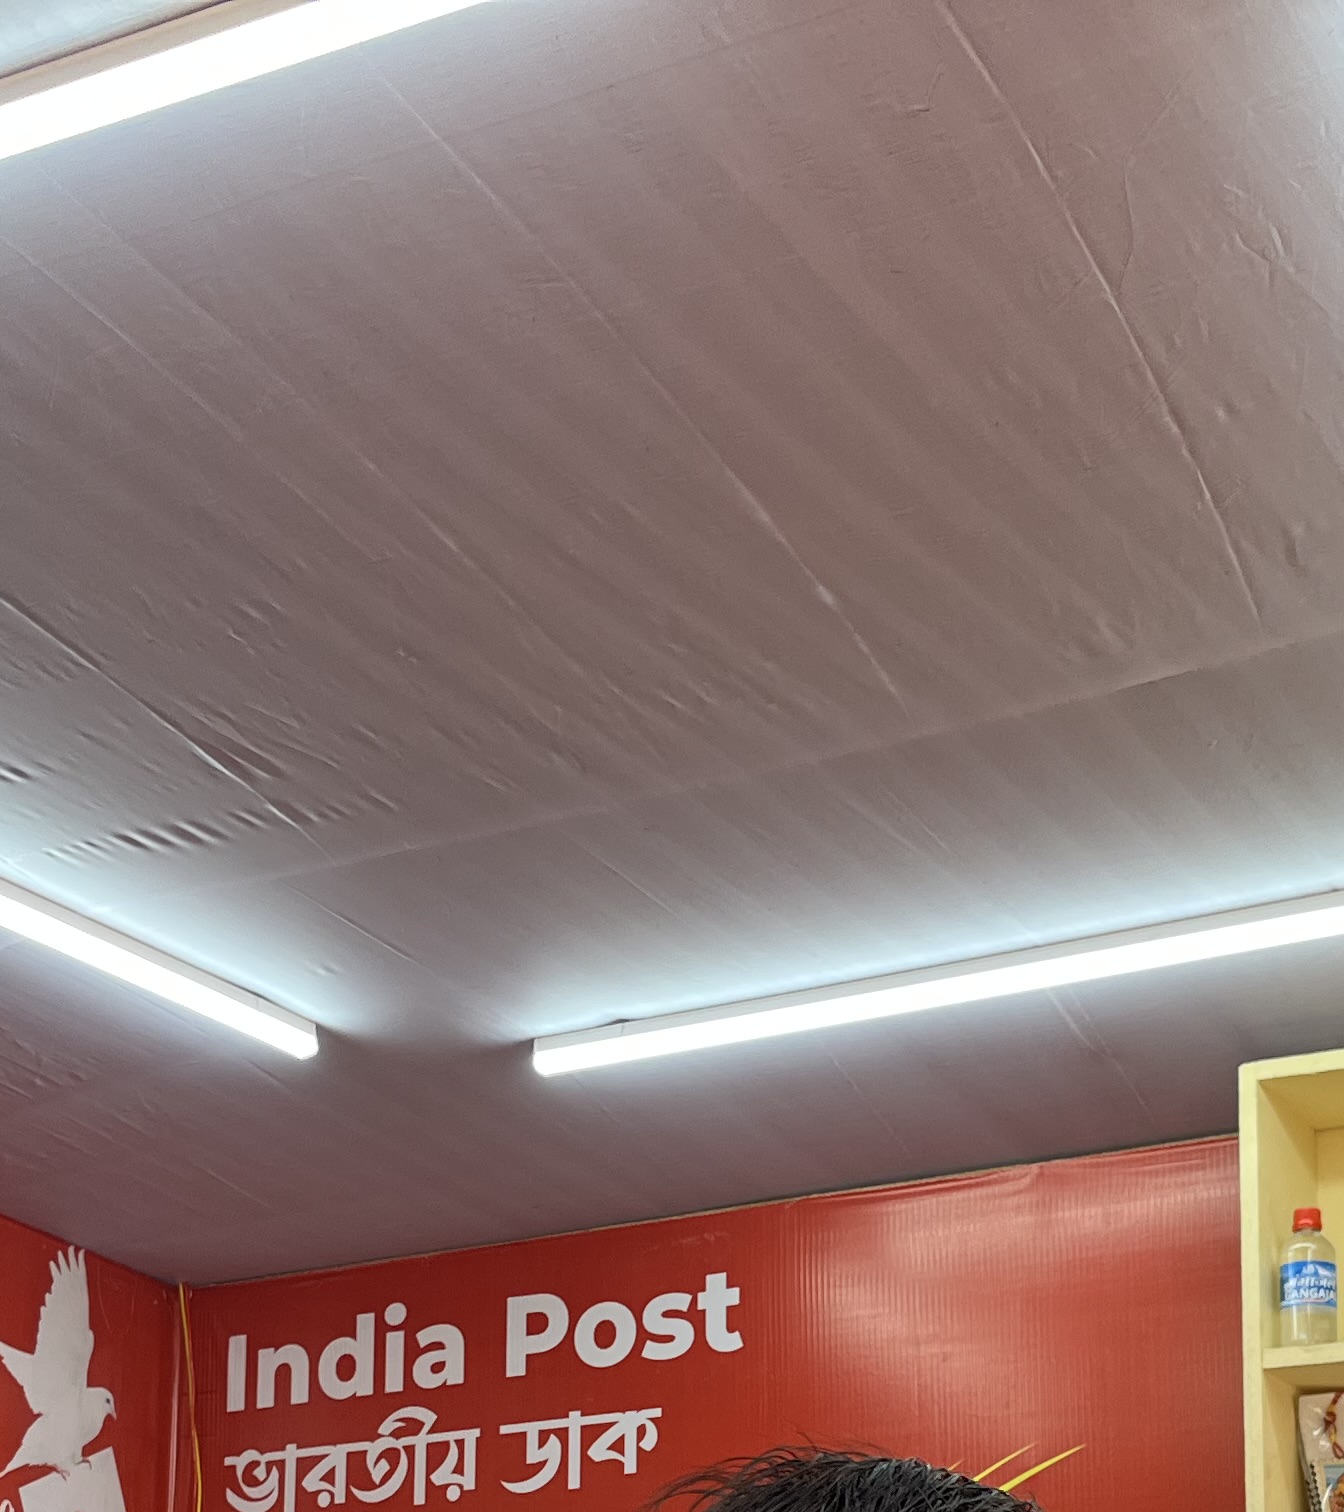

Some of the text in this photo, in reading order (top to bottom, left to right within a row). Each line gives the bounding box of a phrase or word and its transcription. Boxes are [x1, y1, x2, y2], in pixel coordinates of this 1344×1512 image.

[226, 1271, 745, 1413] India Post
[499, 1407, 663, 1494] ডাক
